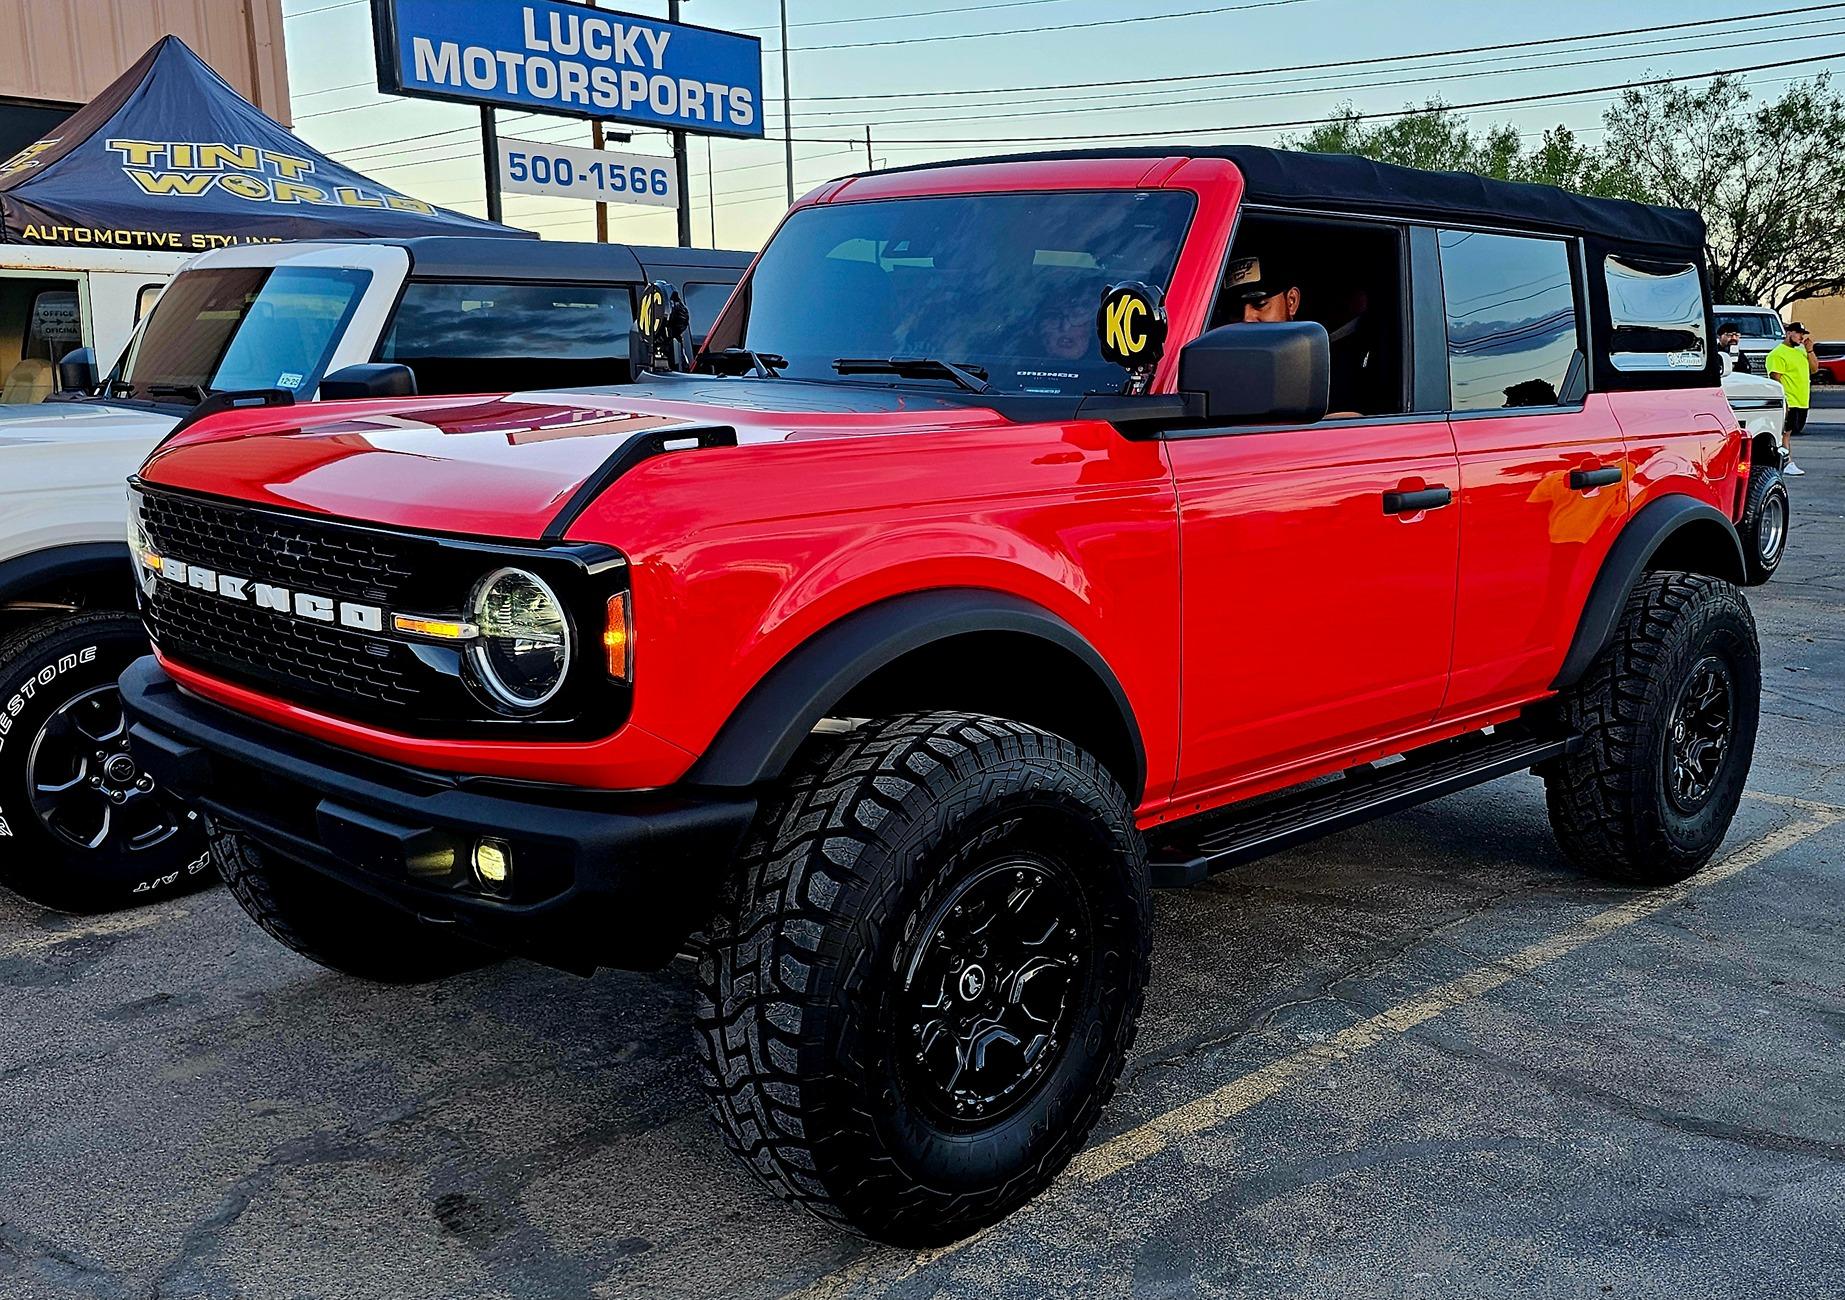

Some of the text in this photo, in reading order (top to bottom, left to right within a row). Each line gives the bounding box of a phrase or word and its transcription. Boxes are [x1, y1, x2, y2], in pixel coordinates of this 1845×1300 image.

[522, 7, 671, 70] LUCKY
[413, 37, 754, 126] MOTORSPORTS
[106, 138, 316, 182] TINT
[508, 152, 669, 196] 500-1566
[122, 167, 438, 217] WORLD
[22, 224, 183, 248] AUTOMOTIVE
[639, 292, 662, 336] KC
[1106, 294, 1147, 356] KC
[161, 556, 383, 632] BRONCO
